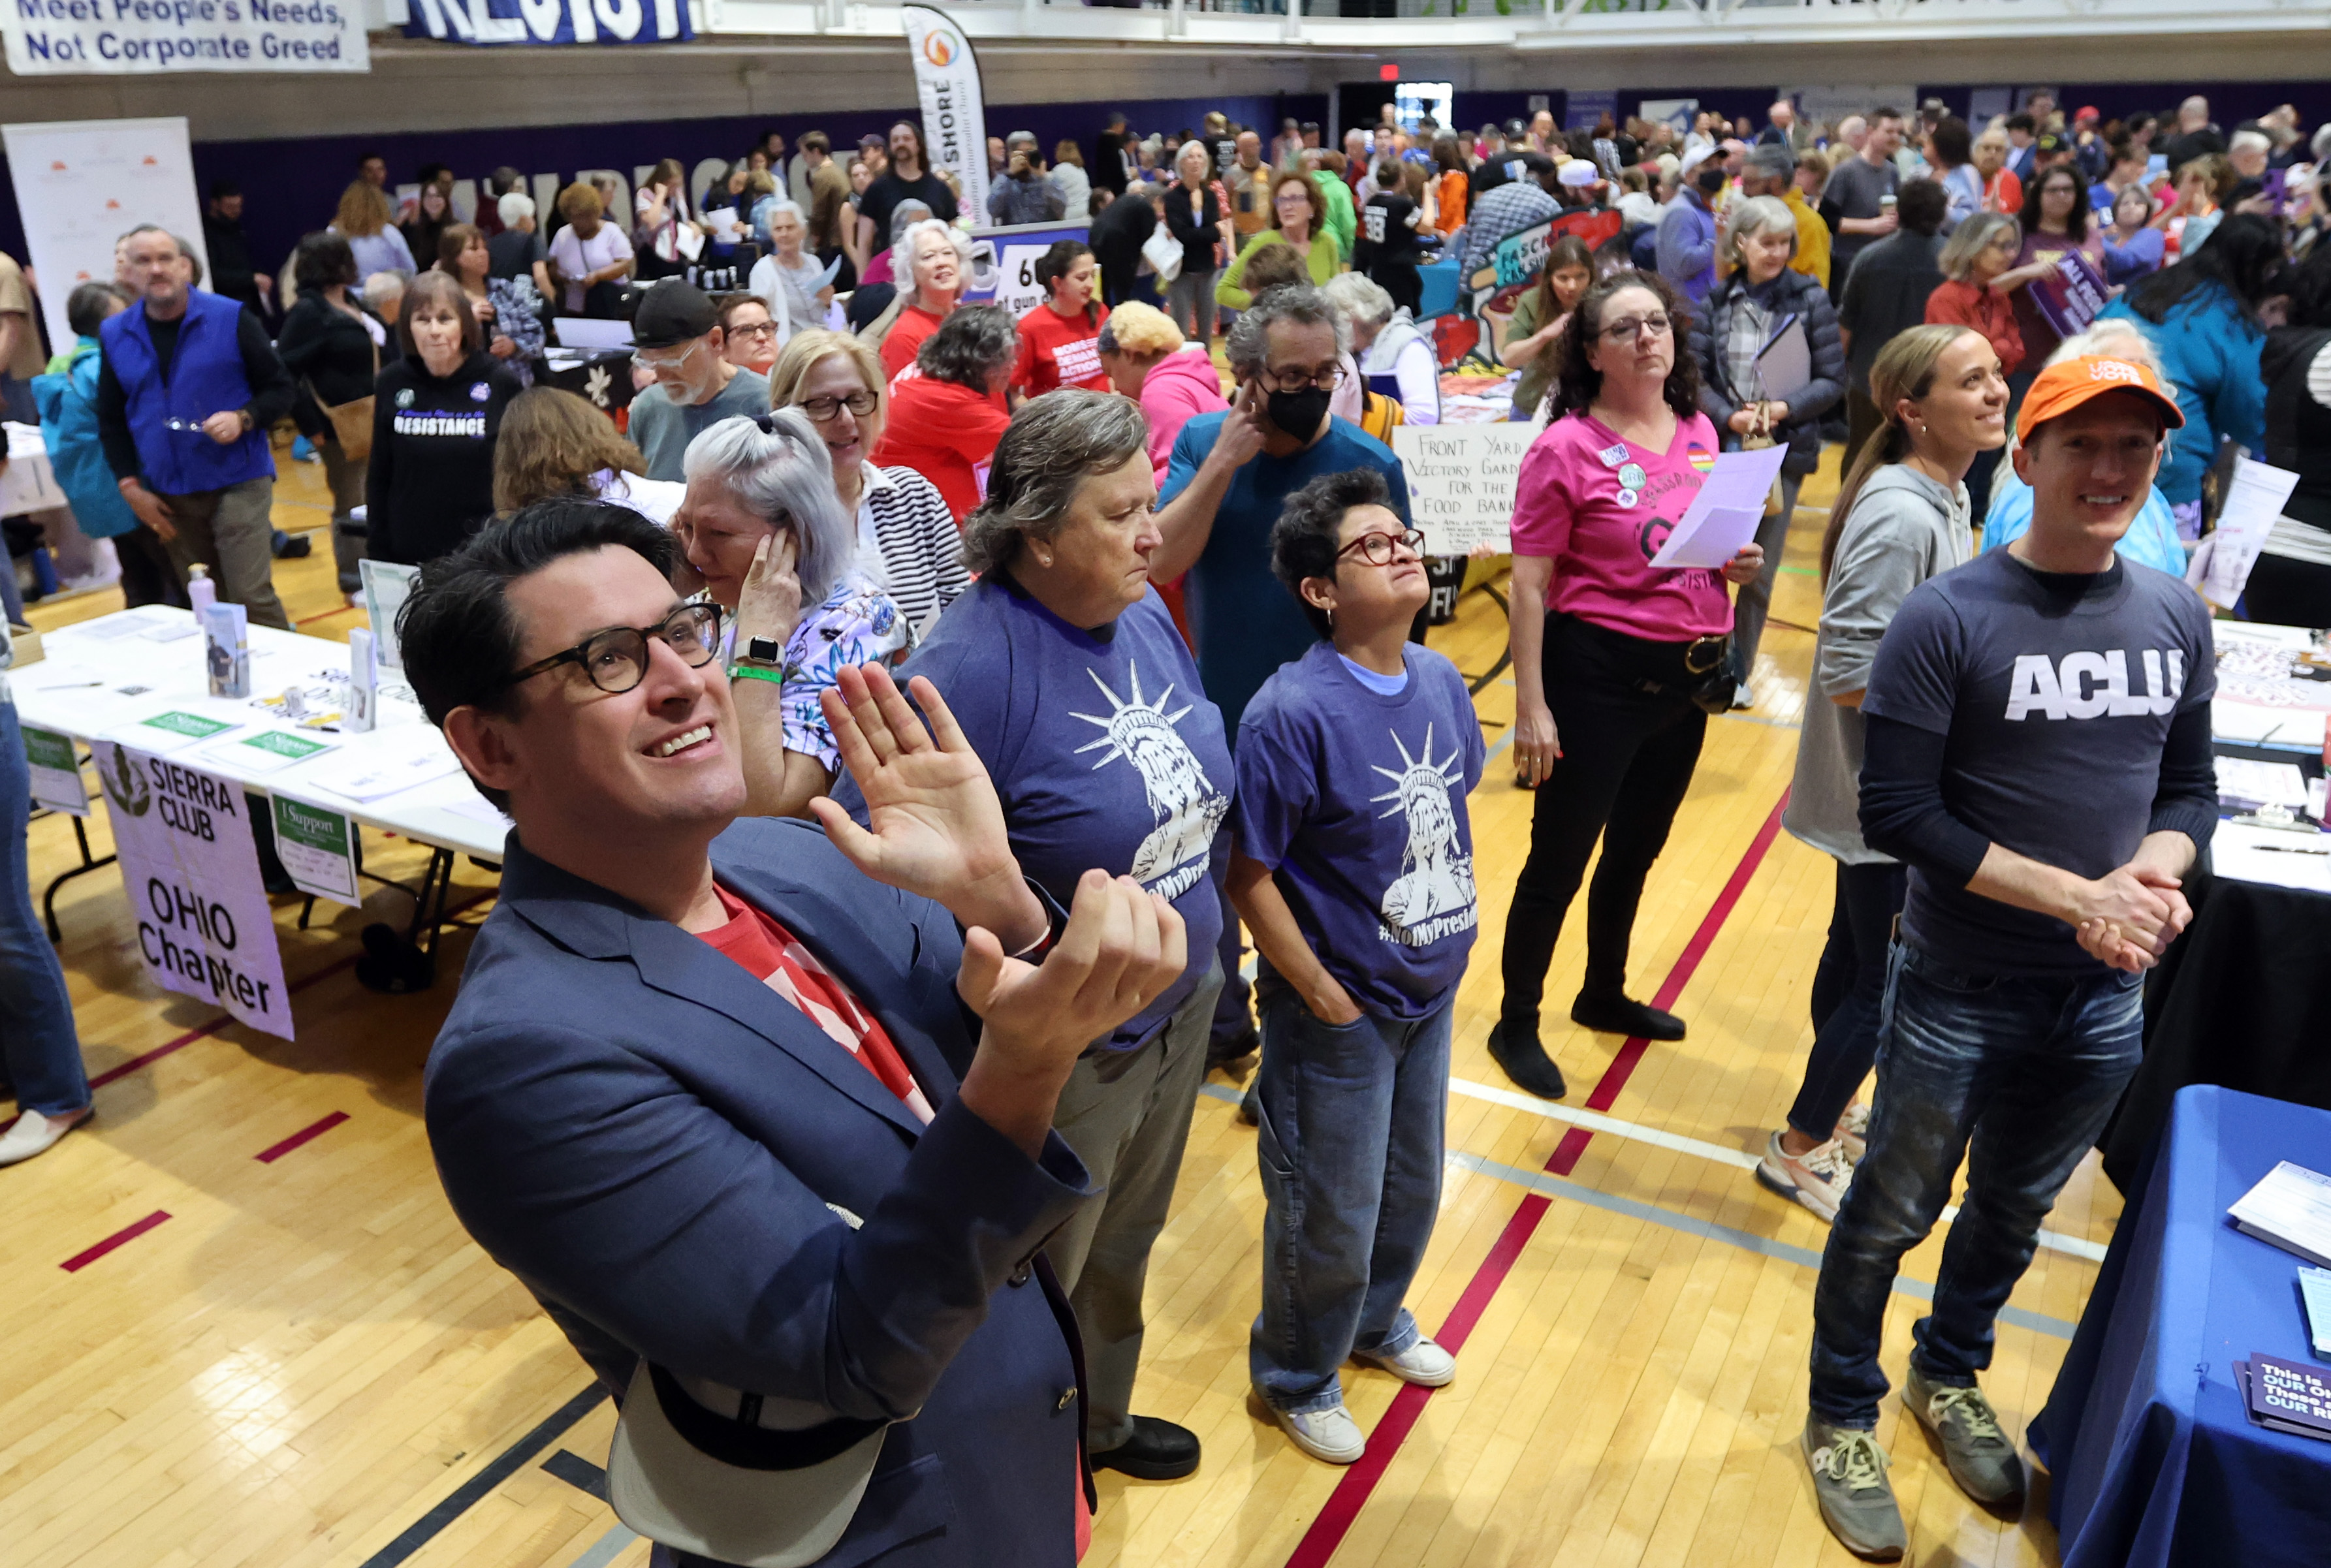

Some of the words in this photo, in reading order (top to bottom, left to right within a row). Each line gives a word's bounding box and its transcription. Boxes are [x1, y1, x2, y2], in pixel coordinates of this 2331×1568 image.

[17, 0, 104, 21] Meet
[250, 0, 347, 29] Needs,
[25, 30, 87, 61] Not
[97, 31, 251, 65] Corporate
[262, 32, 341, 61] Greed
[935, 78, 960, 164] SHORE
[1013, 294, 1037, 313] gun
[1052, 339, 1087, 356] MOMS
[1056, 348, 1103, 366] DEMAN
[1059, 359, 1102, 377] ACTION
[2090, 371, 2143, 386] VOTE
[394, 415, 486, 436] RESISTANCE
[1418, 433, 1468, 456] FRONT
[1484, 435, 1522, 455] YARD
[1408, 457, 1472, 478] VICTORY
[1482, 458, 1519, 475] GARD
[1449, 480, 1473, 495] FOR
[1482, 481, 1509, 495] THE
[1423, 497, 1462, 514] FOOD
[2005, 650, 2183, 721] ACLU
[150, 757, 236, 817] SIERRA
[159, 796, 215, 841] CLUB
[282, 802, 287, 818] I
[288, 805, 334, 834] Support
[148, 877, 236, 950] OHIO
[1378, 901, 1478, 947] #NotMyPresid
[138, 920, 270, 1014] Chapter
[2261, 1363, 2302, 1382] This
[2305, 1374, 2323, 1387] is
[2262, 1374, 2306, 1393] OUR
[2309, 1386, 2331, 1399] OH
[2263, 1383, 2321, 1406] These
[2264, 1394, 2309, 1414] OUR
